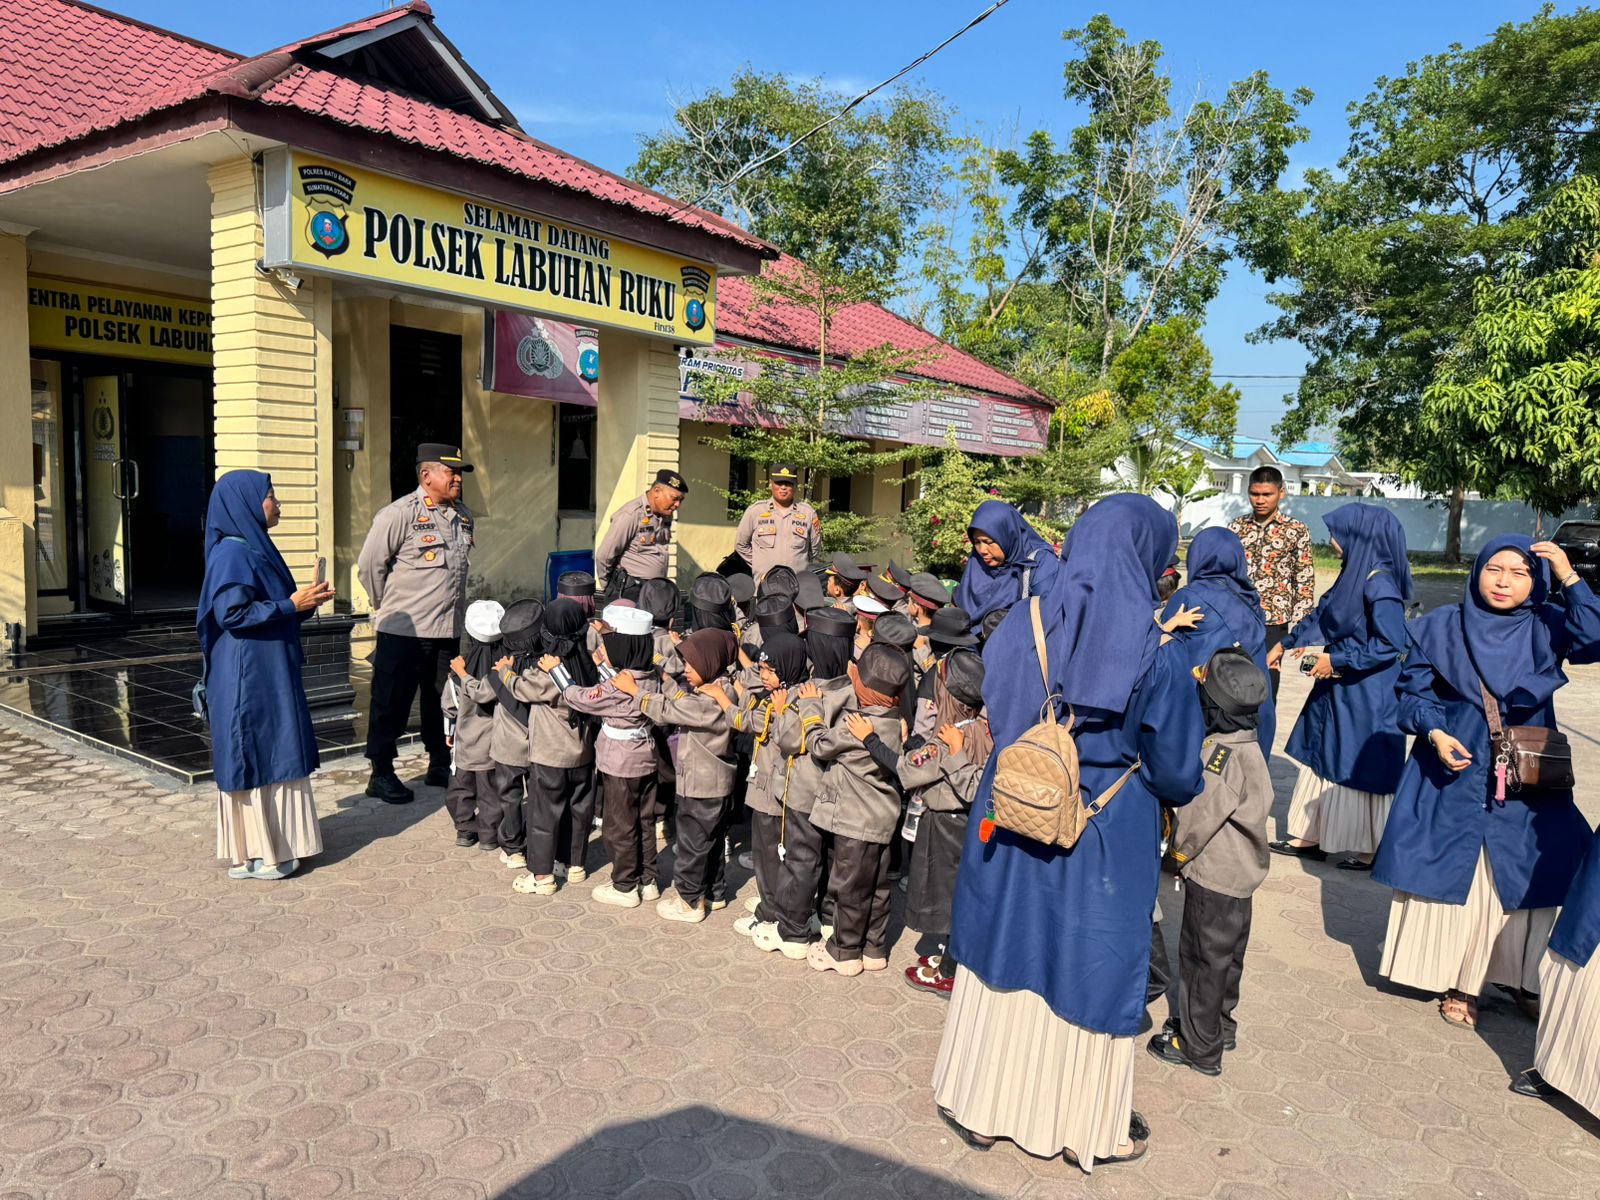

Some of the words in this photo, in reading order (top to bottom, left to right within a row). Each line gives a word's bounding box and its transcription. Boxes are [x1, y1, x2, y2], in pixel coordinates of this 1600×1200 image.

[306, 184, 333, 192] SUMATERA
[334, 188, 350, 200] UTARA
[464, 202, 542, 242] SELAMAT
[547, 224, 610, 261] DATANG
[363, 207, 485, 280] POLSEK
[494, 237, 612, 308] LABUHAN
[619, 269, 677, 322] RUKU
[88, 295, 172, 323] PELAYANAN
[65, 315, 141, 345] POLSEK
[702, 359, 744, 376] PRIORITAS
